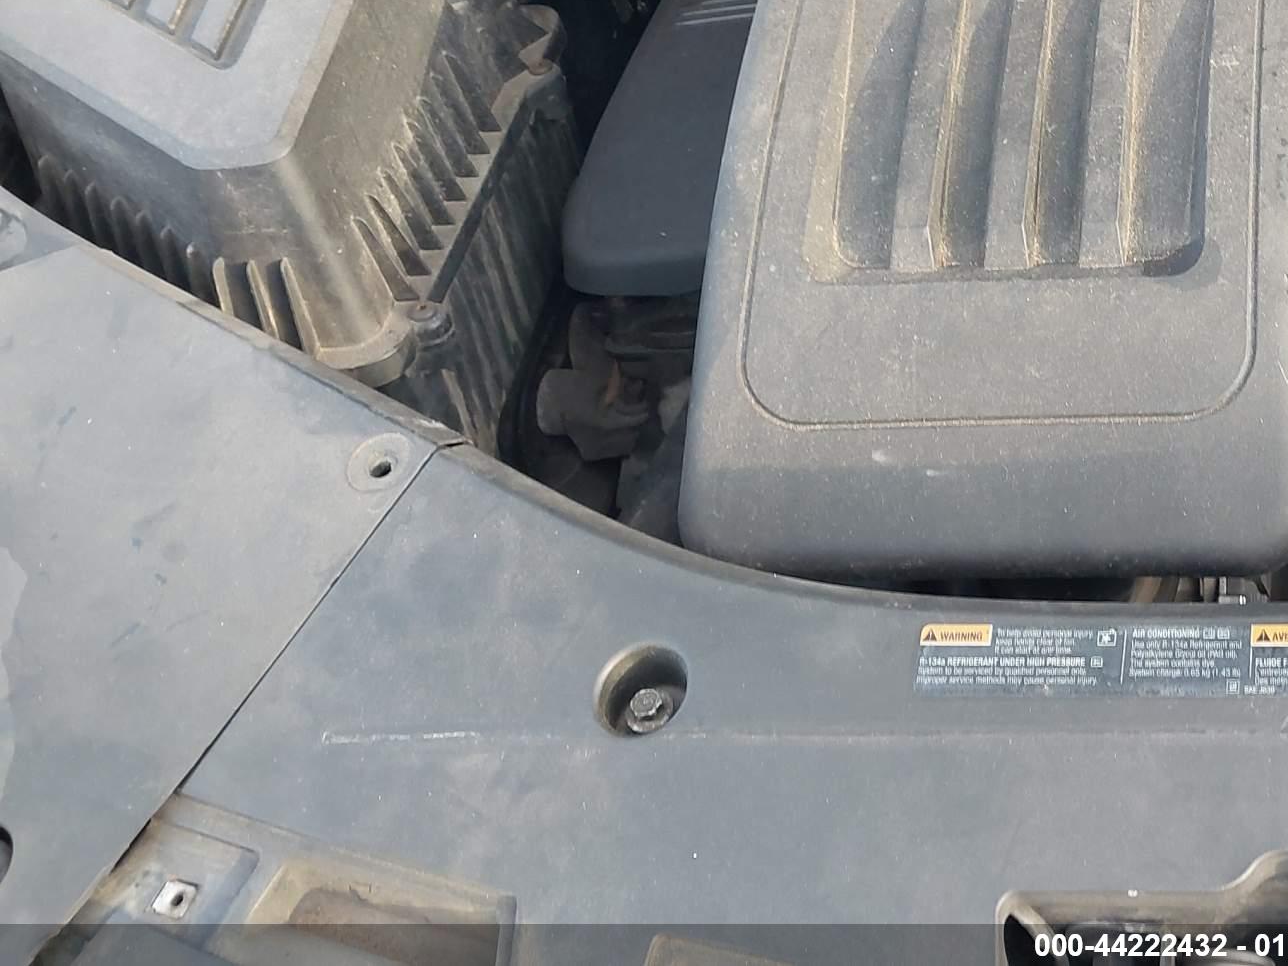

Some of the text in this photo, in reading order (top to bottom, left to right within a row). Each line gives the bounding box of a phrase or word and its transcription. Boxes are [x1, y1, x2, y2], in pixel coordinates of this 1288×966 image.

[940, 632, 983, 642] WARNING
[1132, 629, 1200, 639] AIR CONDITIONING
[919, 656, 1085, 666] R-134a REFRIGERANT UNDER HIGH PRESSURE
[1255, 658, 1281, 668] FLUIDE
